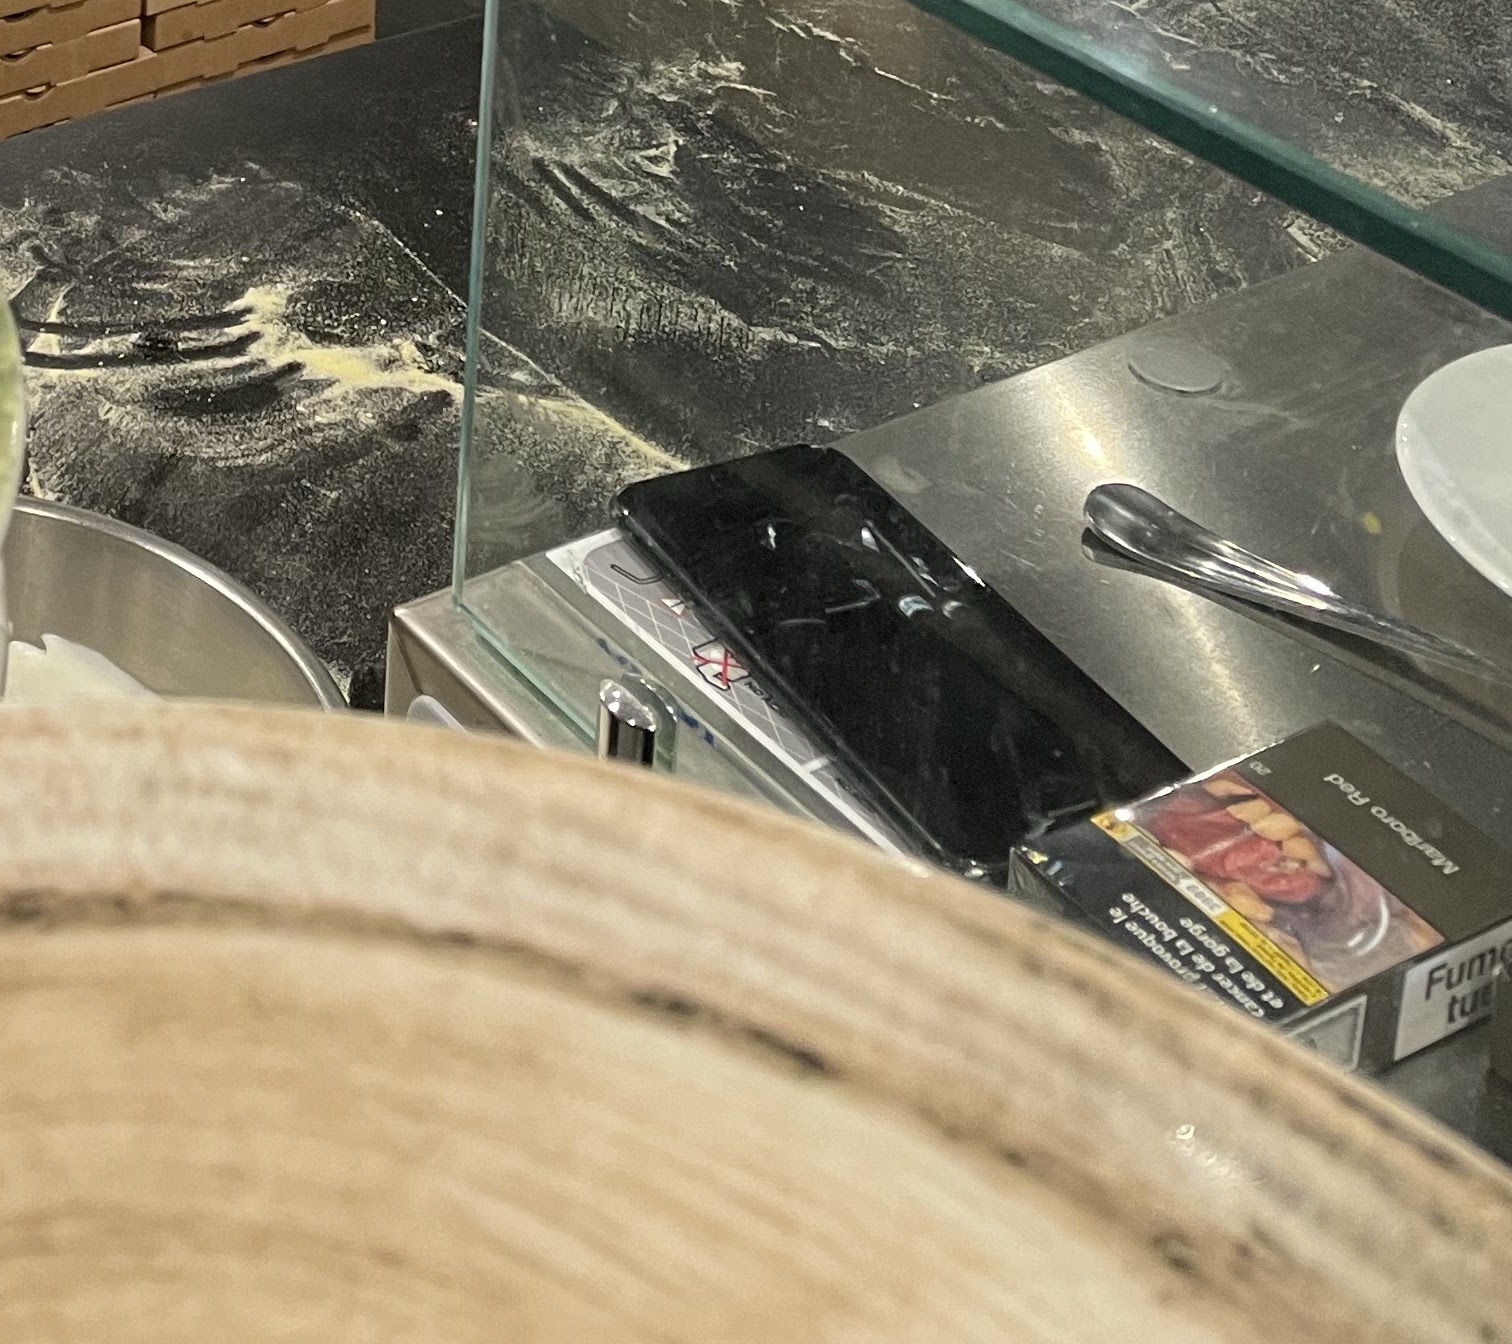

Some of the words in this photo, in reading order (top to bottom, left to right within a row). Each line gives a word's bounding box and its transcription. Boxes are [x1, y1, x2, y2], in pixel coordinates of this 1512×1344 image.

[1250, 761, 1272, 776] 20
[1323, 773, 1370, 806] Red
[1370, 806, 1461, 874] Marlboro
[1108, 905, 1128, 924] le
[1121, 892, 1178, 942] bouche
[1175, 938, 1195, 956] la
[1179, 916, 1230, 958] gorge
[1125, 920, 1202, 983] provoque
[1191, 953, 1216, 973] de
[1224, 956, 1244, 974] la
[1240, 970, 1265, 992] de
[1211, 972, 1265, 1017] cancer
[1260, 990, 1284, 1009] et
